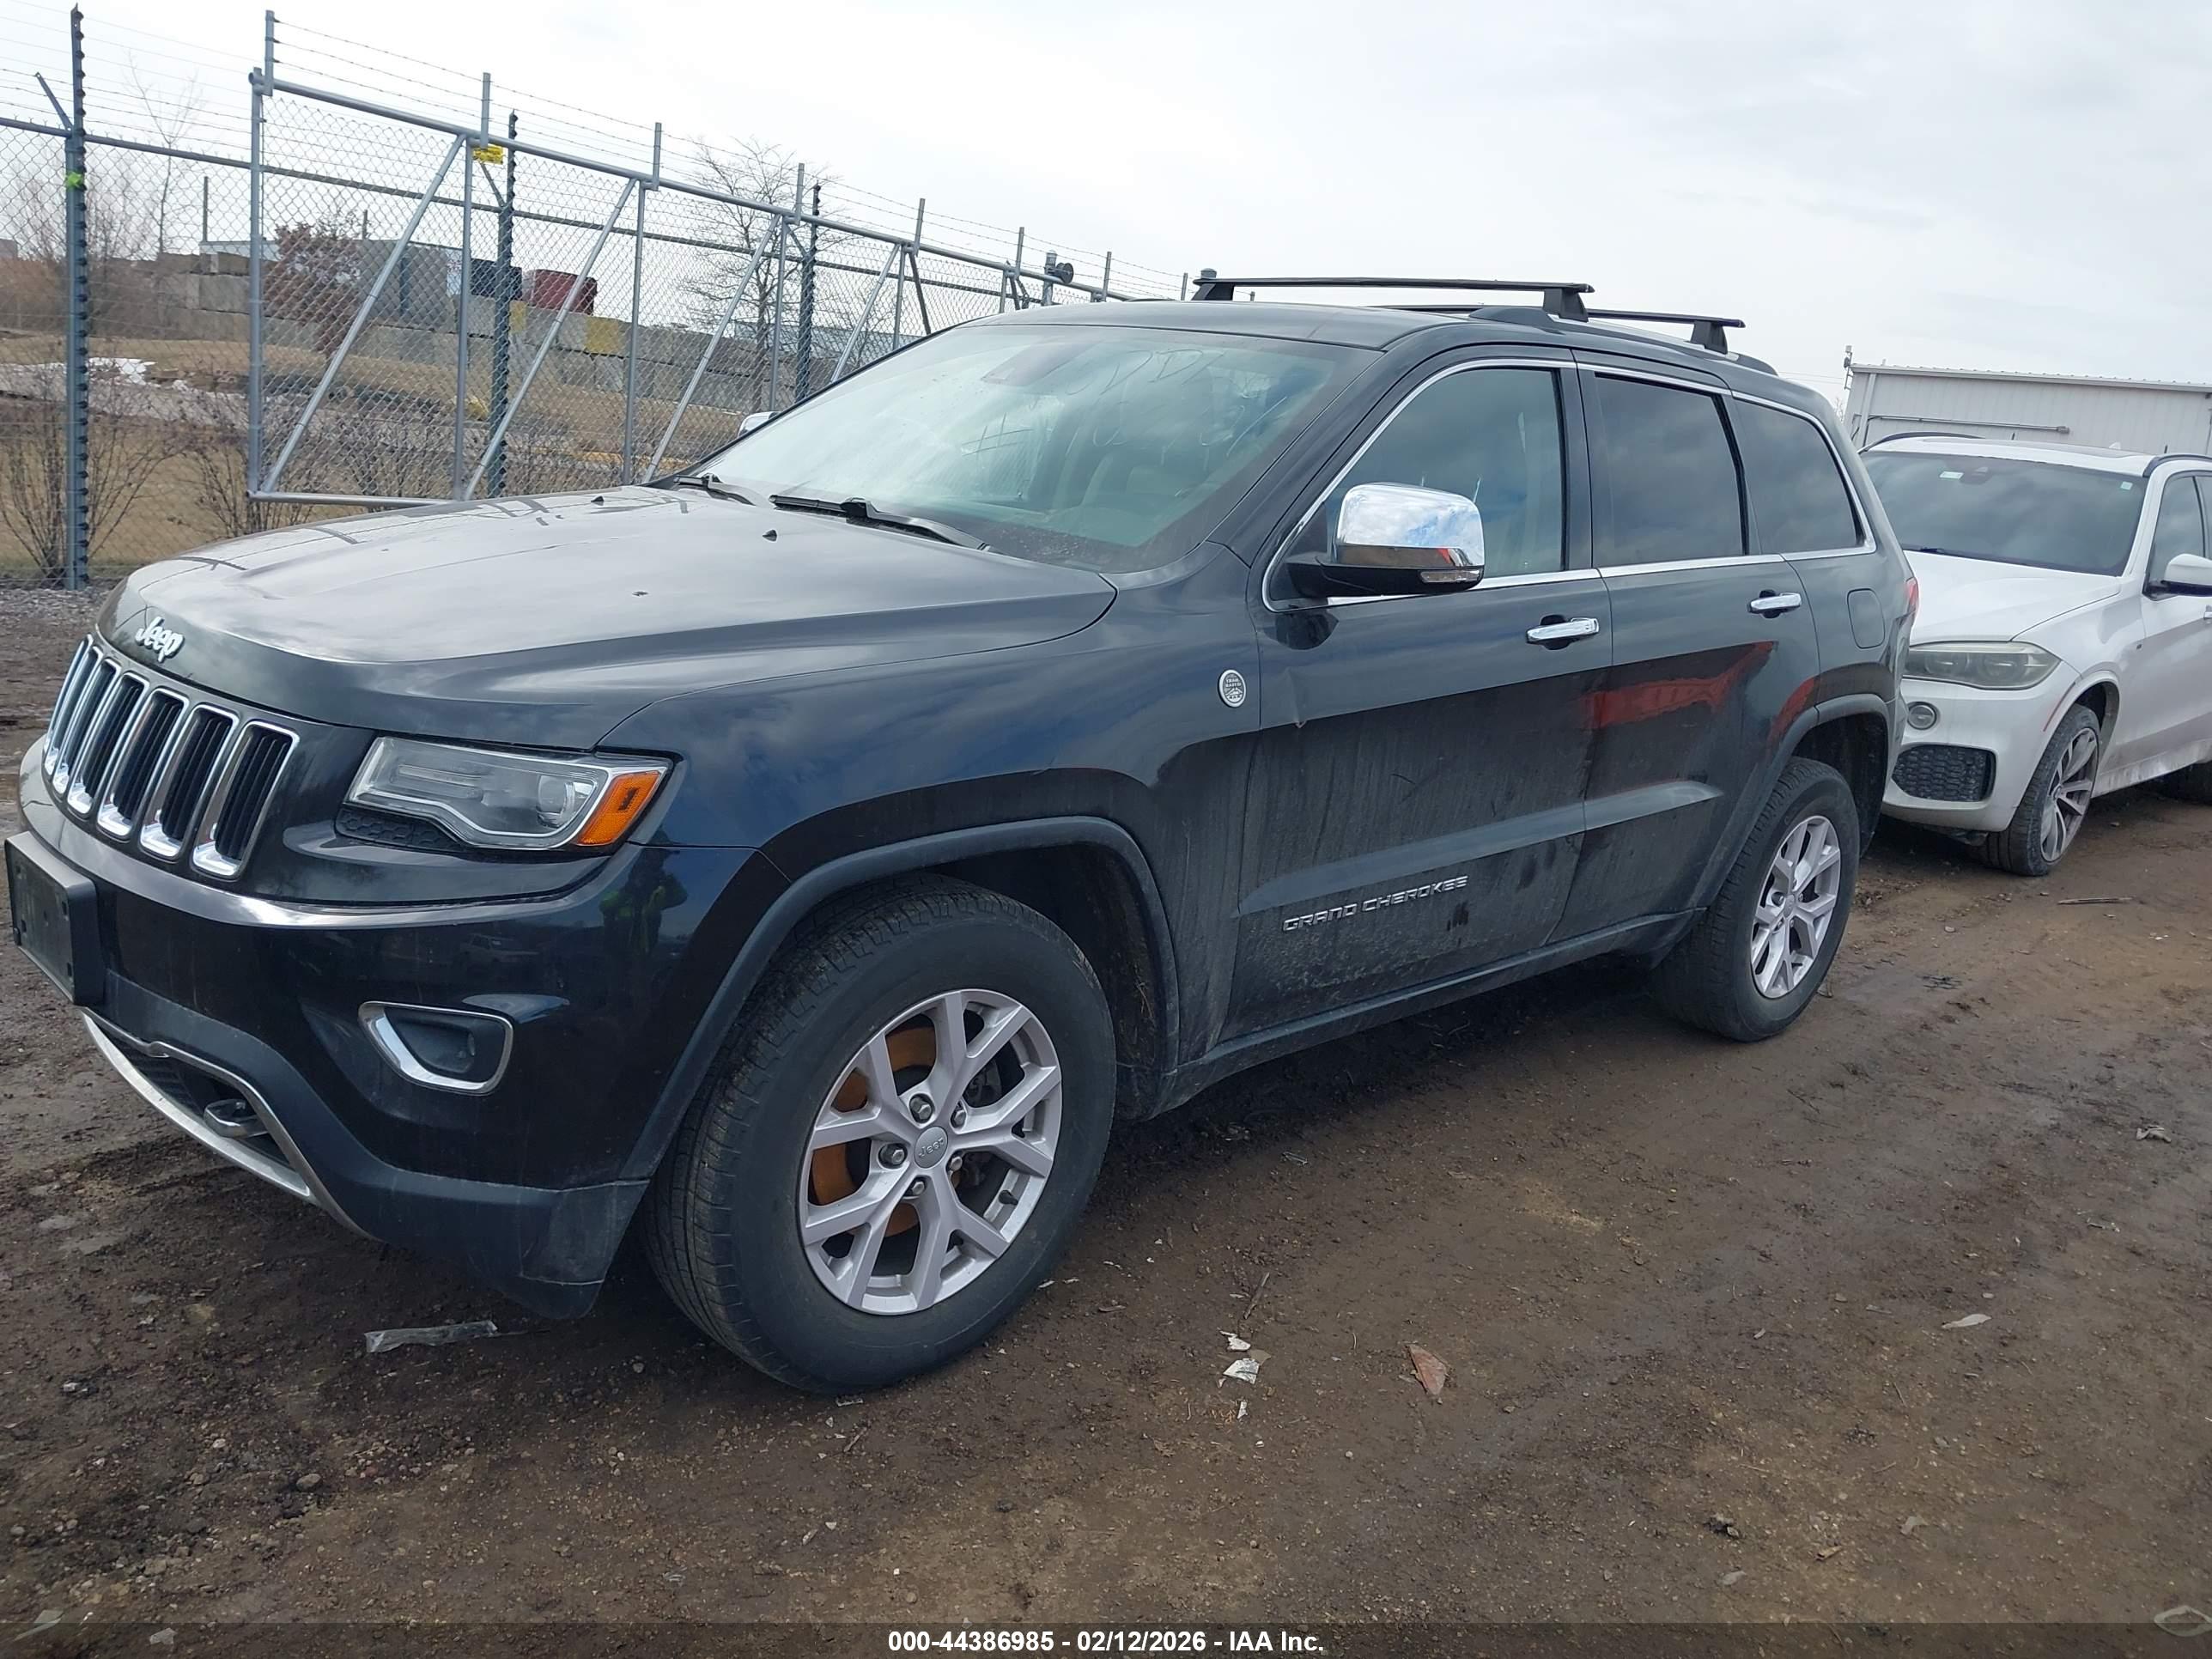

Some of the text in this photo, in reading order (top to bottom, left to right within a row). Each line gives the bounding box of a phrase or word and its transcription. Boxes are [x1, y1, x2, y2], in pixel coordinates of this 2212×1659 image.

[135, 616, 185, 663] Jeep
[1282, 875, 1468, 931] GRAND CHEROKEE
[919, 1137, 944, 1158] Jeep
